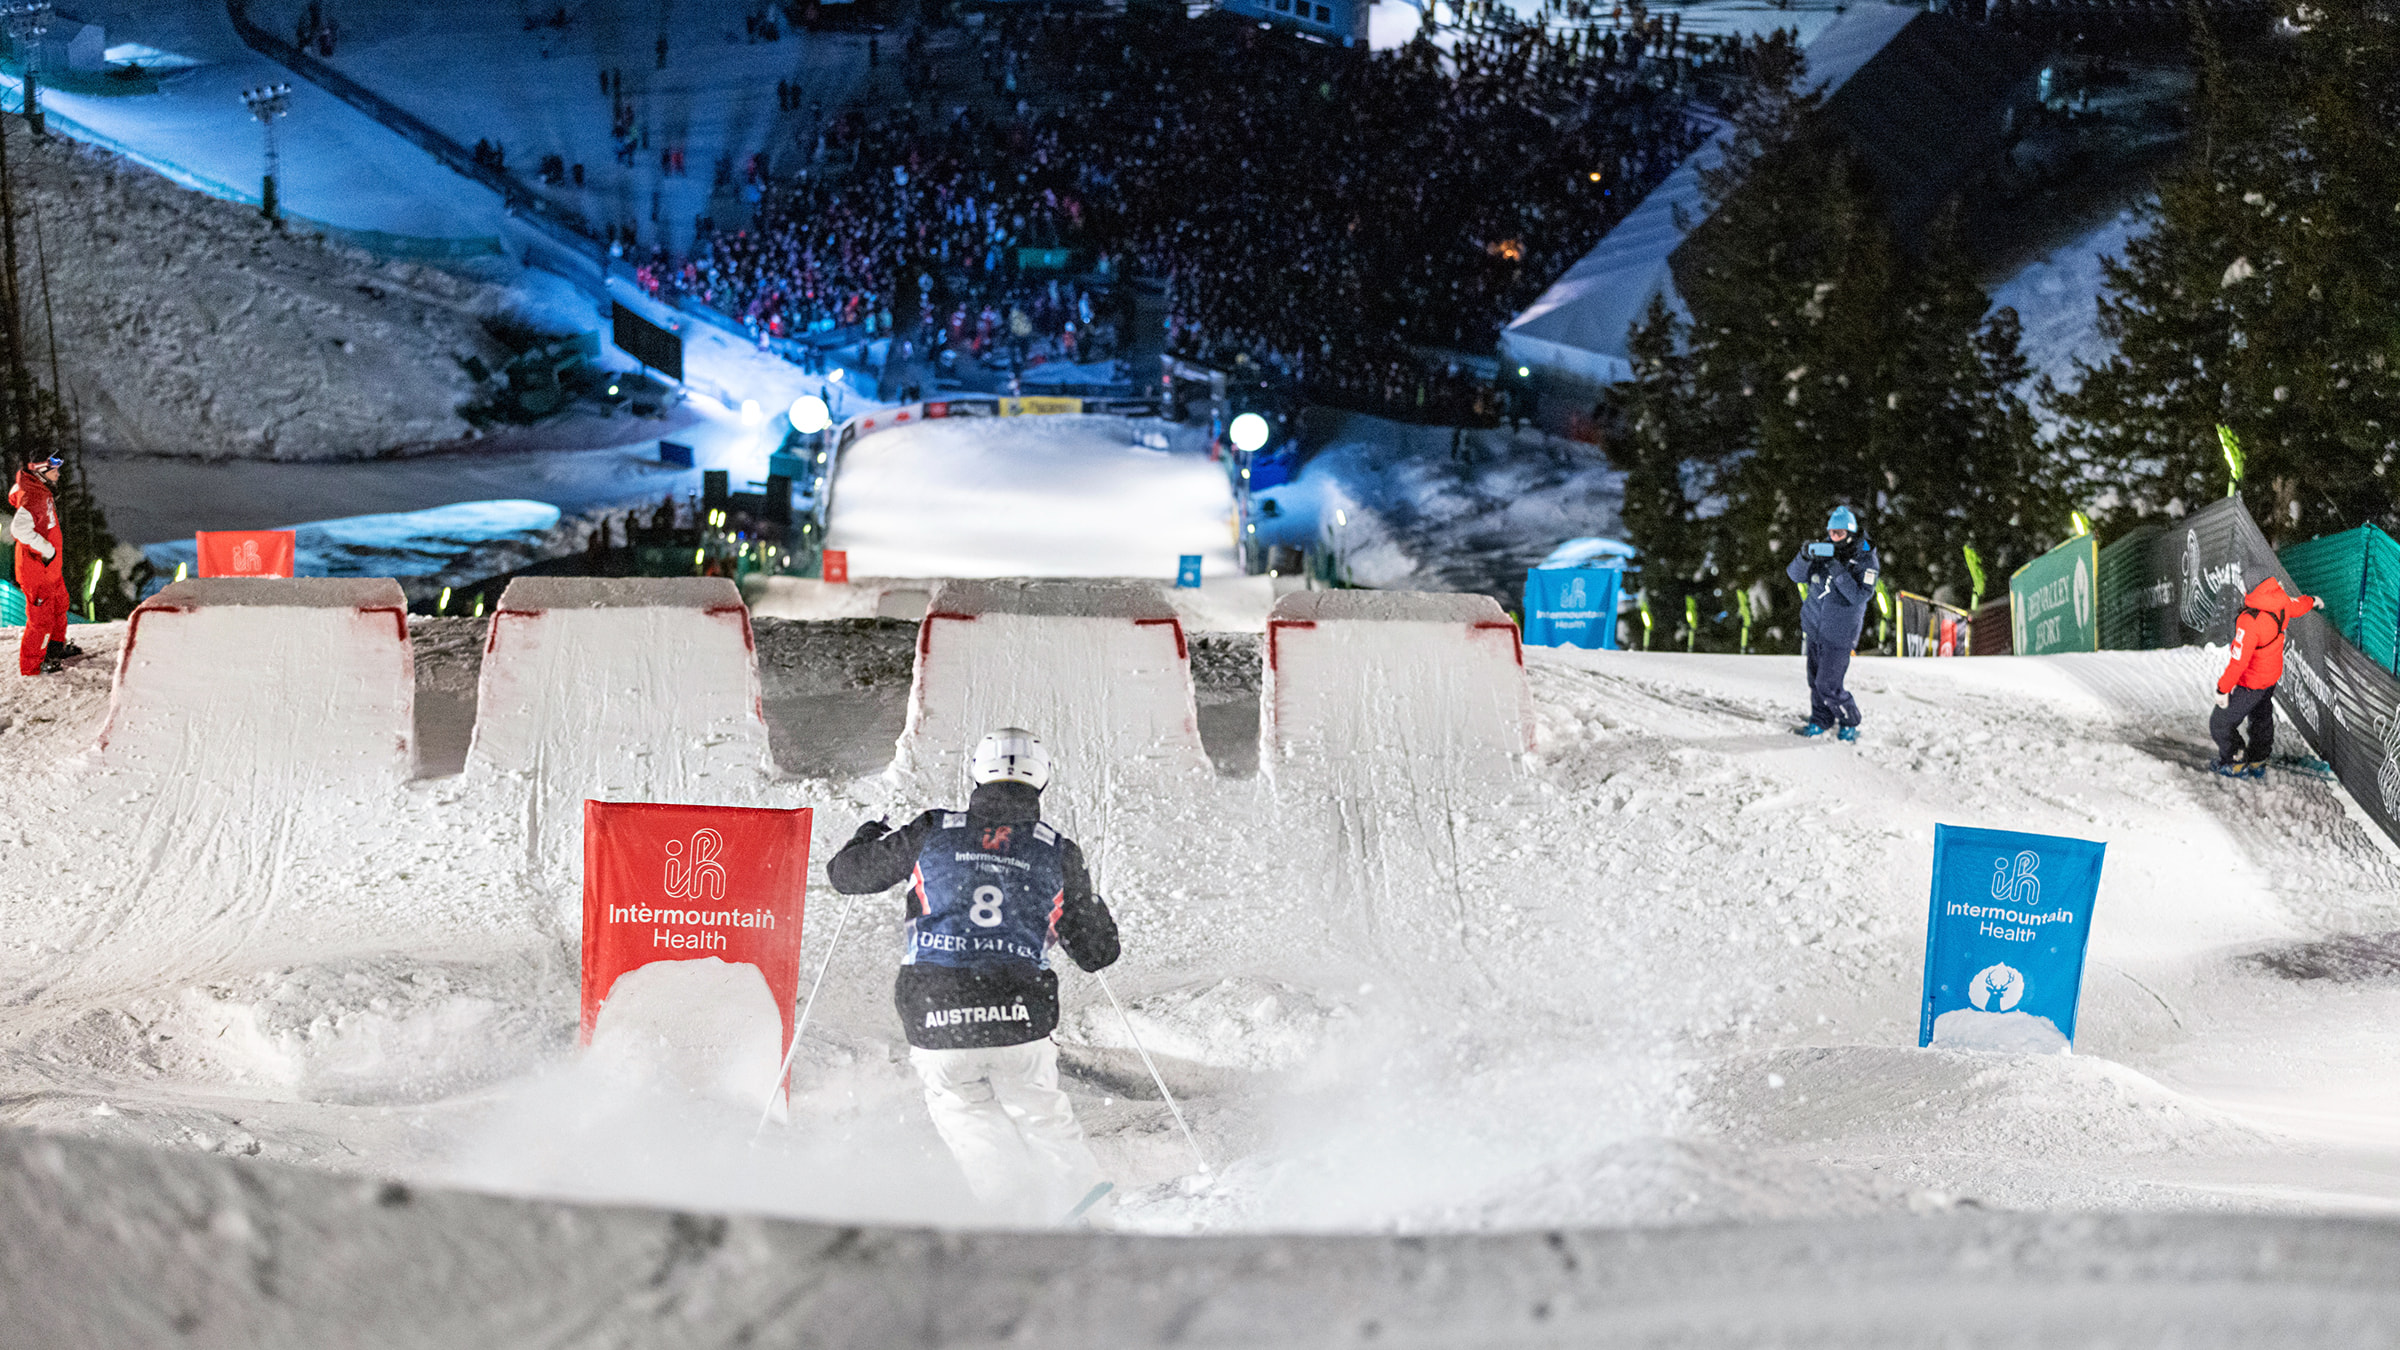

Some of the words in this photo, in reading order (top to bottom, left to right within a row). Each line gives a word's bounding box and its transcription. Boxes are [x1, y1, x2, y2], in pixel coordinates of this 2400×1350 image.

[1536, 610, 1606, 619] Intermountain
[1555, 620, 1586, 629] Health
[955, 851, 1031, 871] Intermountain
[608, 903, 775, 930] Intermountain
[969, 884, 1003, 928] 8
[1947, 900, 2073, 926] Intermountain
[653, 928, 727, 950] Health
[920, 931, 967, 951] DEER
[1979, 921, 2036, 942] Health
[925, 1003, 1030, 1028] AUSTRALIA
